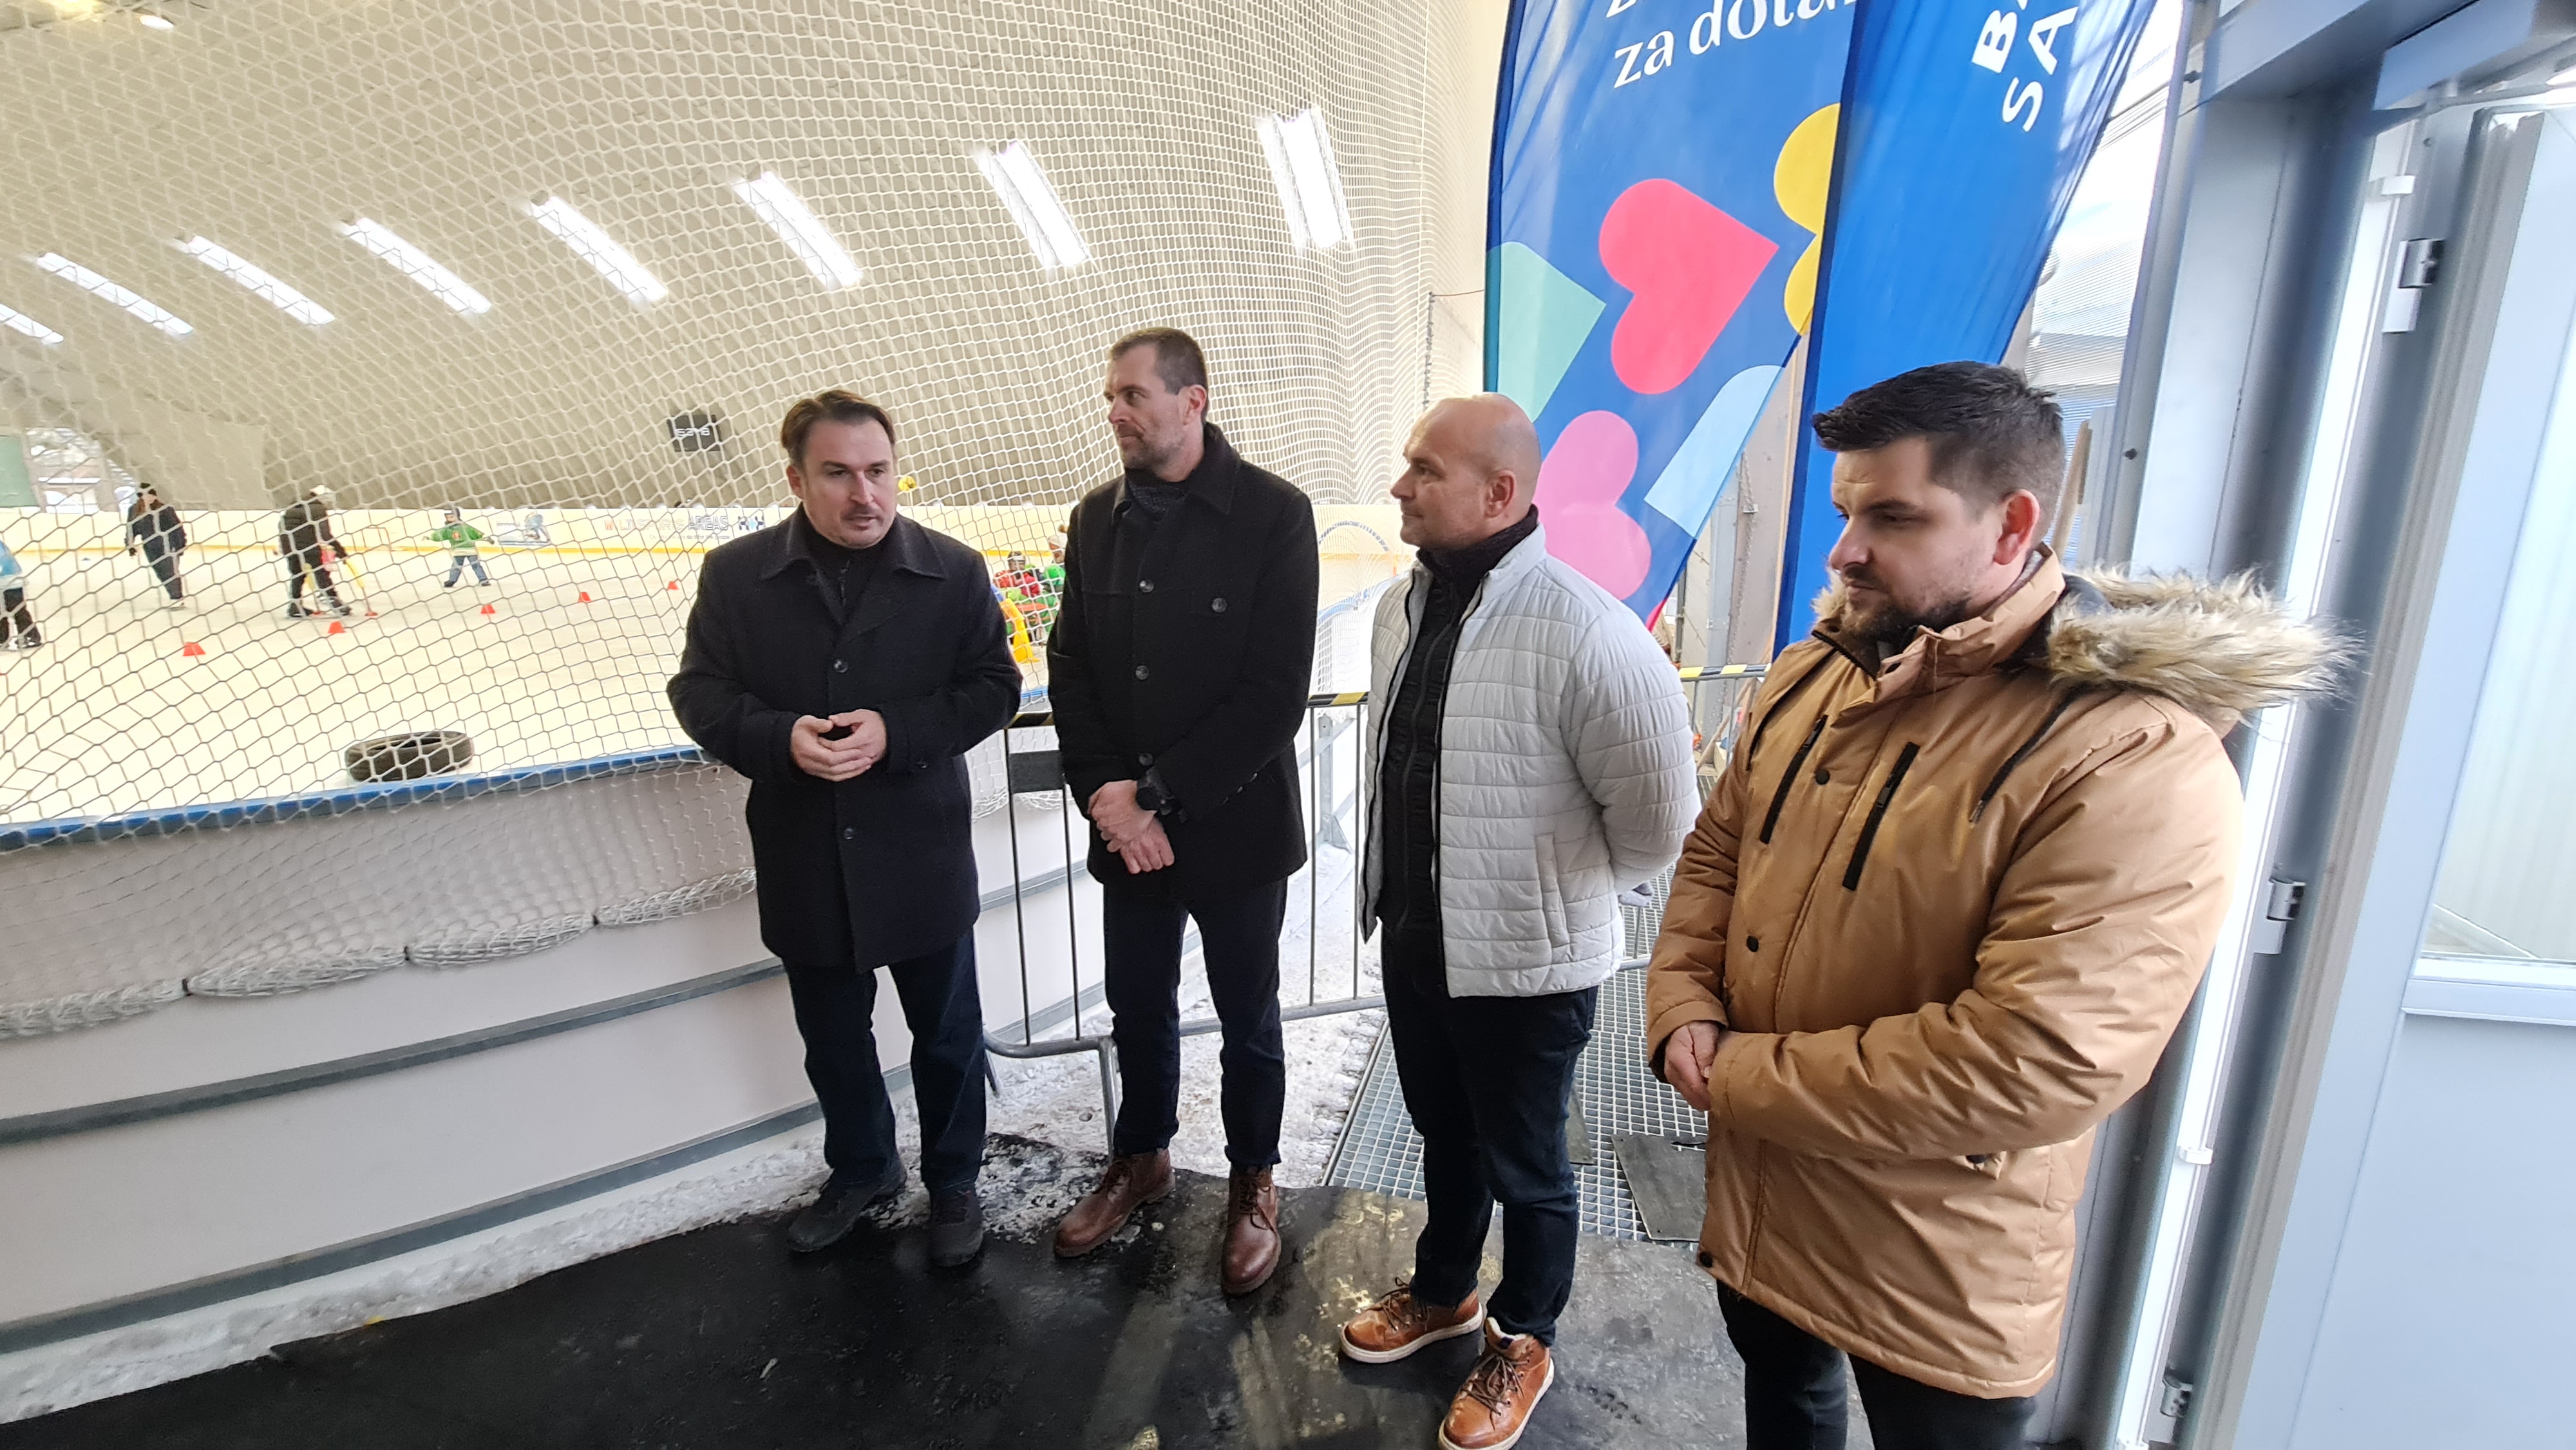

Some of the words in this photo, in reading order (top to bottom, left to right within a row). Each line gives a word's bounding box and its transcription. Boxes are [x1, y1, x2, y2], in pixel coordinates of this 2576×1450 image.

[1614, 30, 1674, 88] za
[2002, 6, 2079, 133] SA
[688, 515, 729, 531] AREAS
